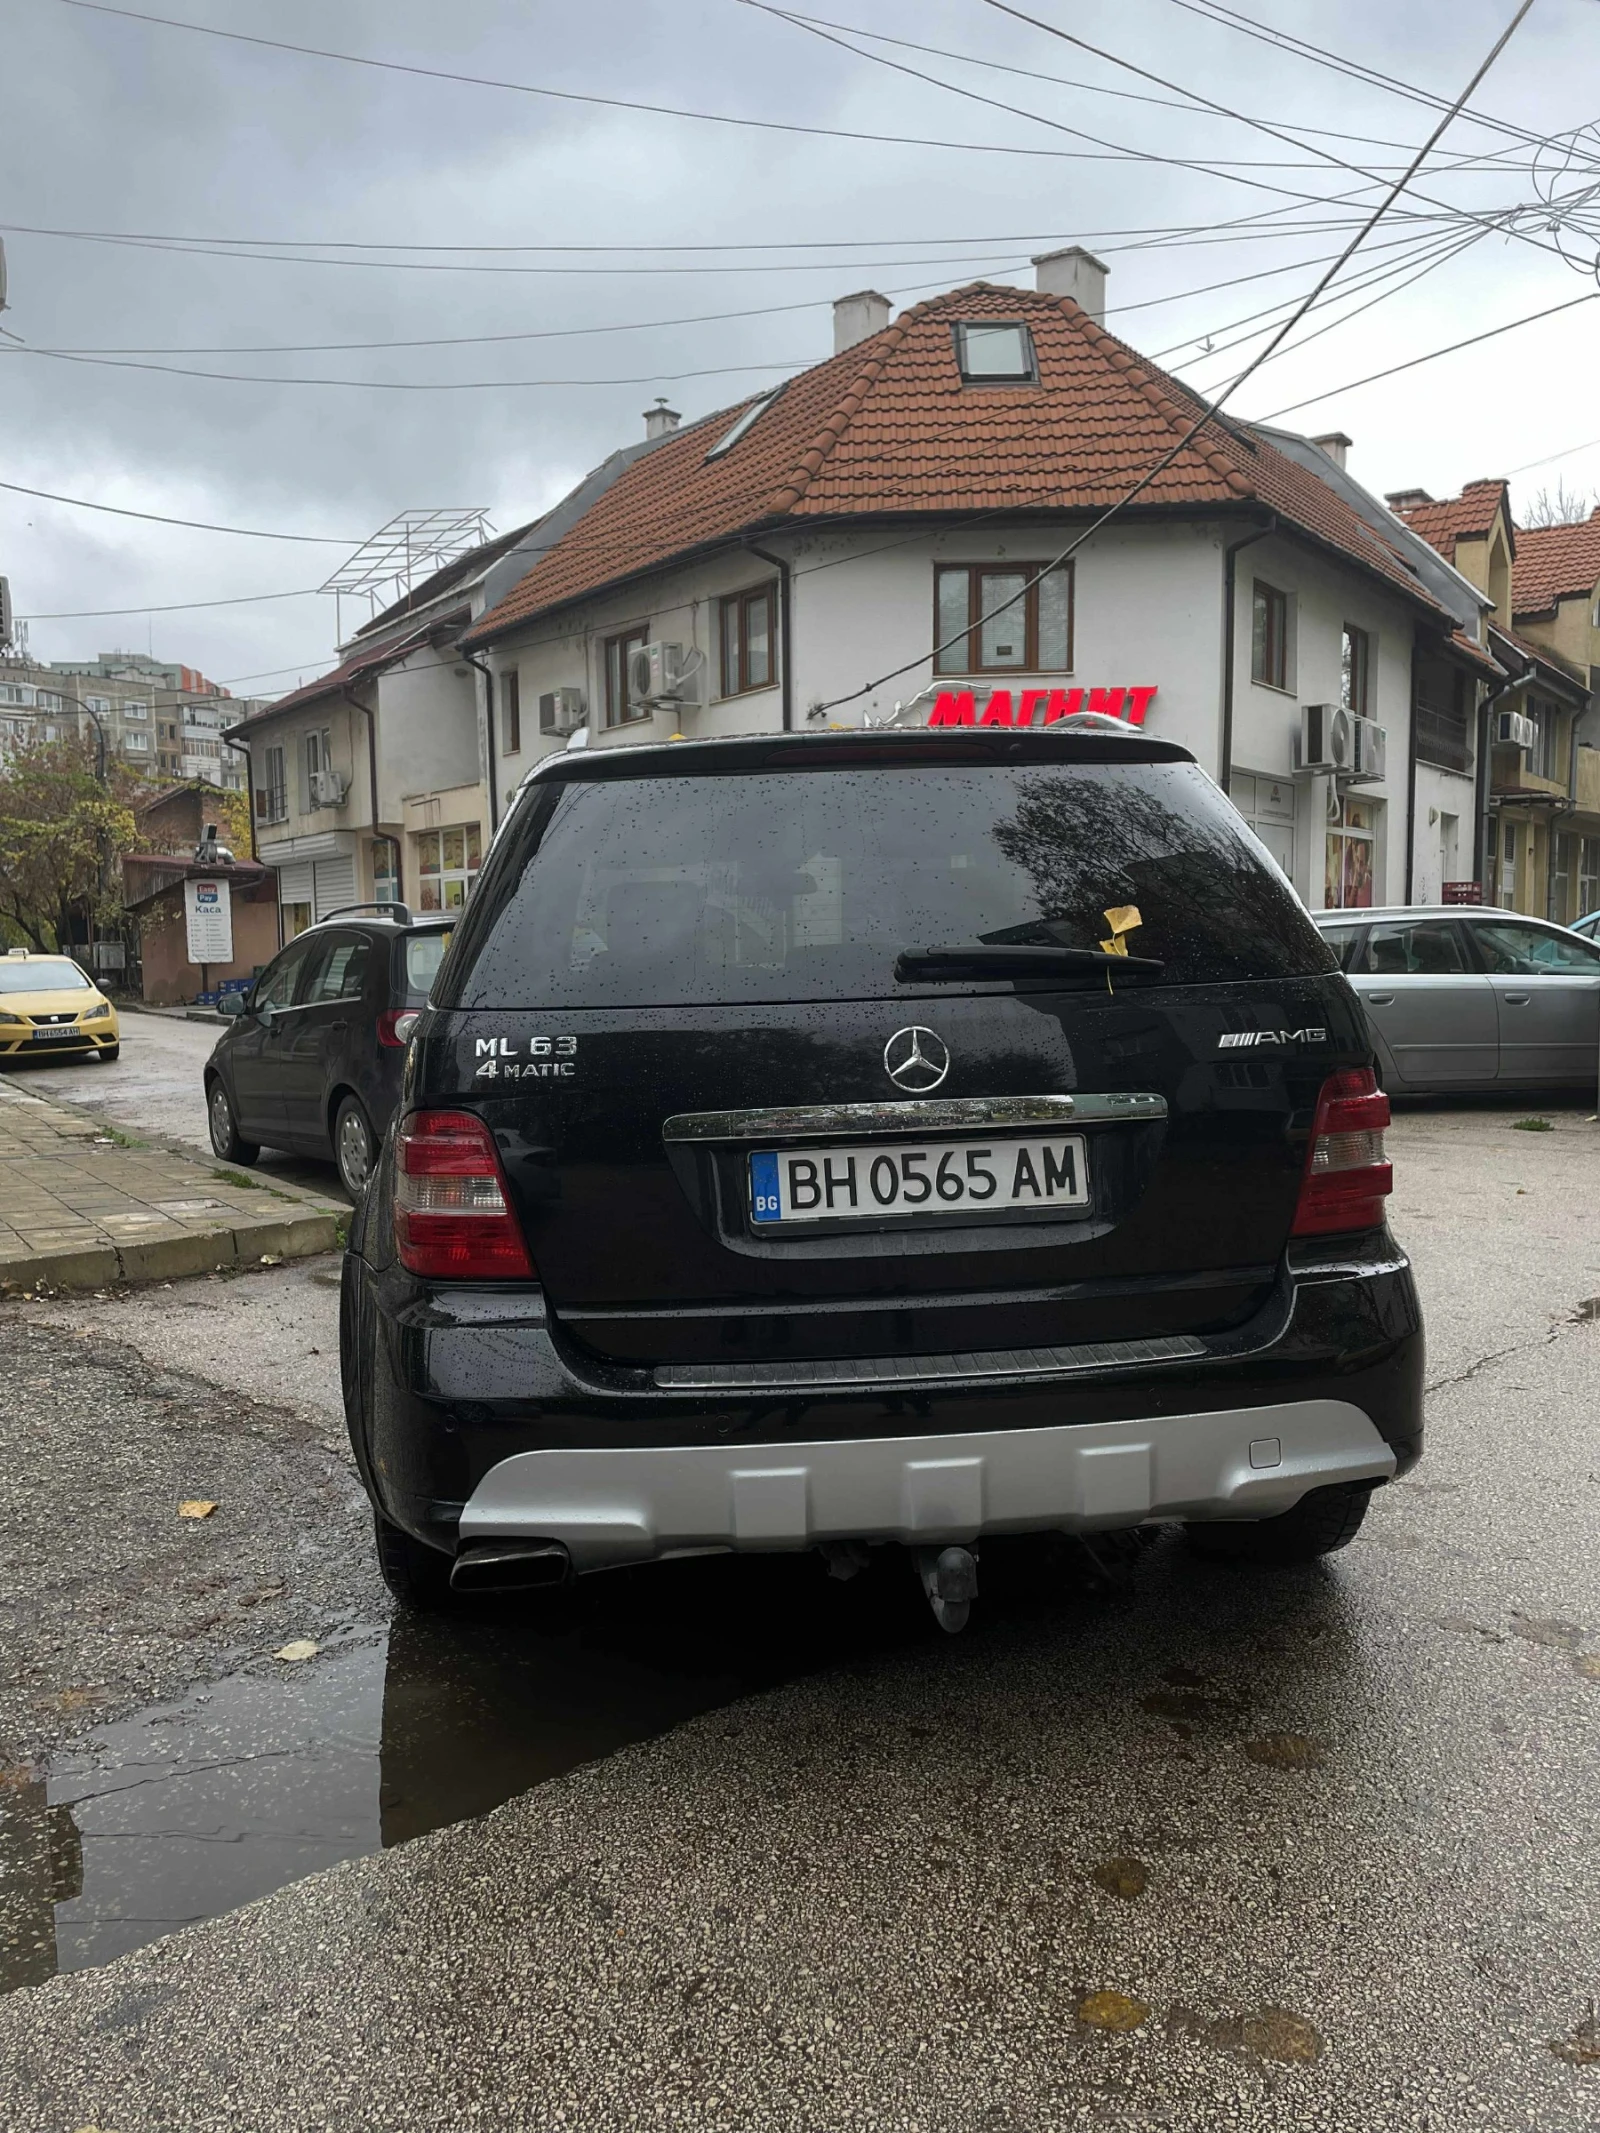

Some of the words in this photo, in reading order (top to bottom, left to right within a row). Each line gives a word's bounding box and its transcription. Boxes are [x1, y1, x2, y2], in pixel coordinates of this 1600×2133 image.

[927, 685, 1158, 727] МАГНИТ
[199, 886, 216, 894] Easy
[199, 894, 213, 902] Pay
[195, 905, 222, 914] Каса
[1254, 1028, 1327, 1046] AMG
[475, 1037, 519, 1057] ML
[530, 1036, 577, 1056] 63
[788, 1157, 859, 1210] BH
[869, 1149, 998, 1205] 0565
[1011, 1145, 1078, 1198] AM
[756, 1196, 778, 1212] BG
